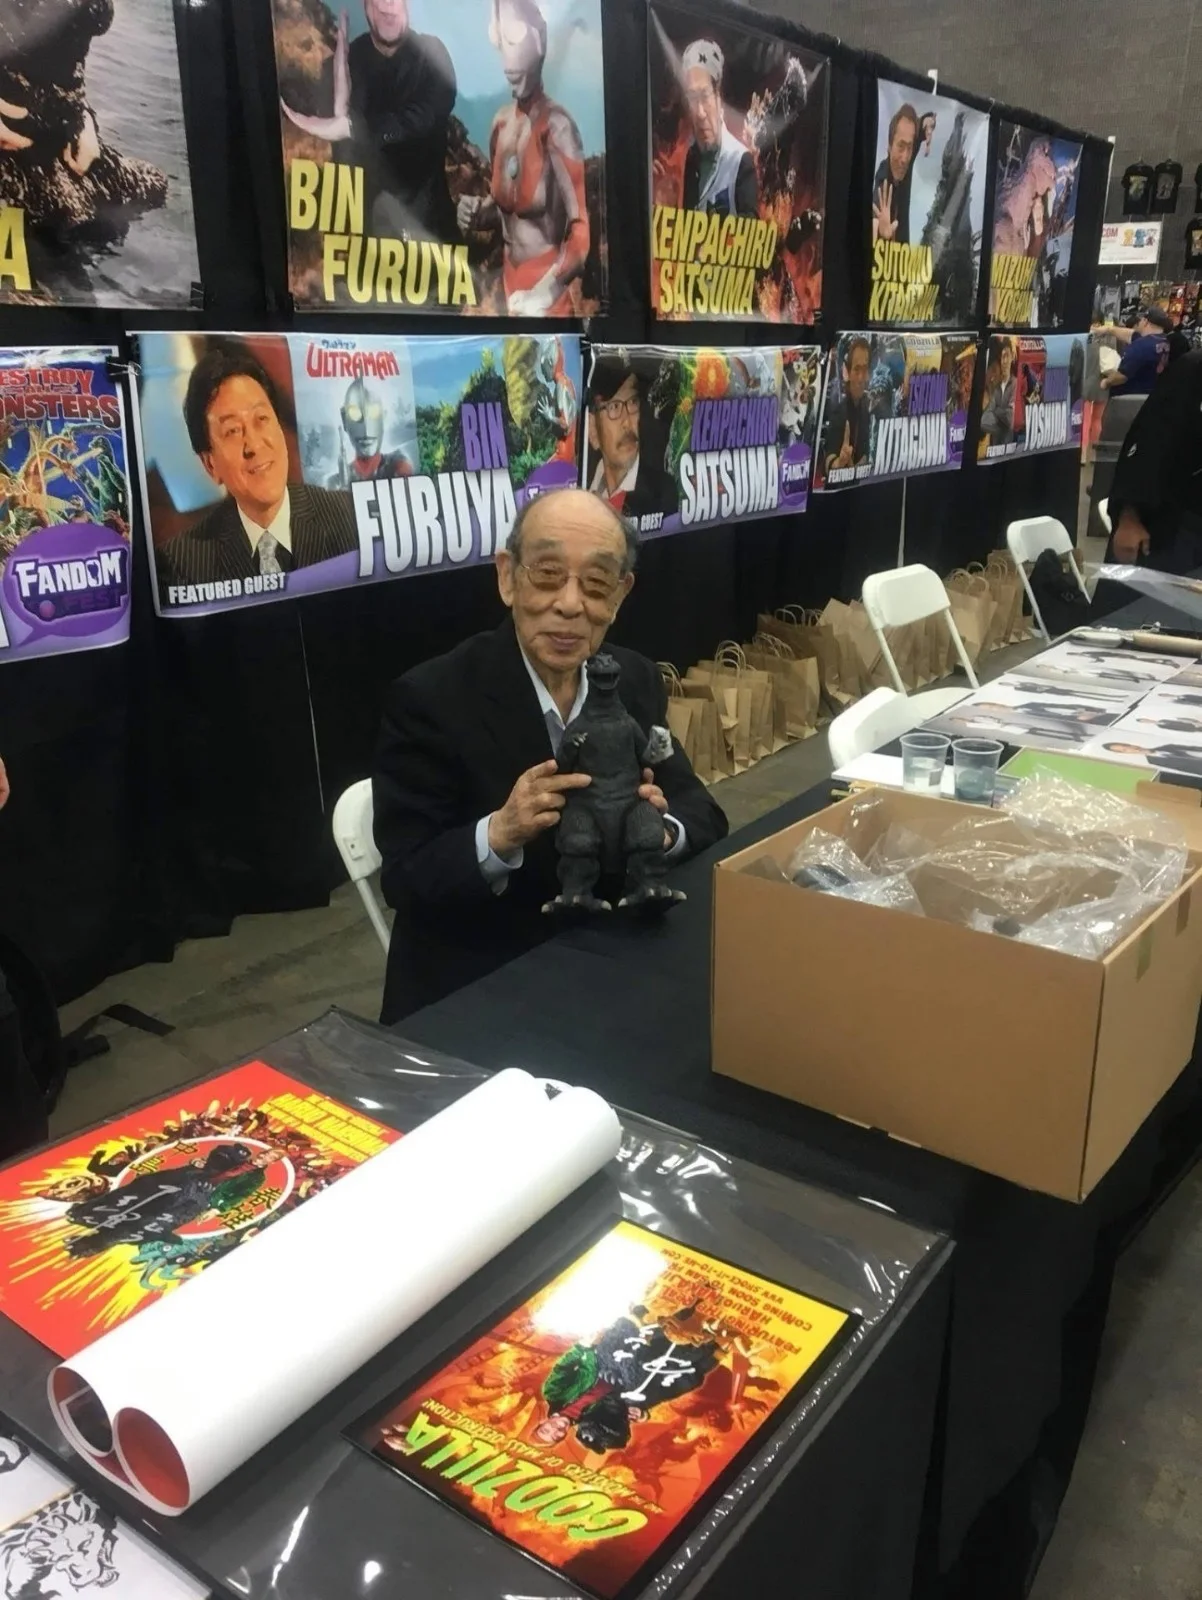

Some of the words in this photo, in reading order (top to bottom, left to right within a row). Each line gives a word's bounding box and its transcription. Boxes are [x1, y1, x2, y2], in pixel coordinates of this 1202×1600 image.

[291, 158, 364, 234] BIN
[323, 234, 477, 305] FURUYA
[660, 260, 756, 315] SATSUMA
[306, 342, 400, 380] ULTRAMAN
[461, 402, 509, 471] BIN
[692, 397, 779, 451] KENPACHIRO
[874, 413, 947, 475] KITAGAWA
[1024, 401, 1067, 451] YOSHIDA
[680, 446, 778, 525] SATSUMA
[352, 470, 517, 577] FURUYA
[641, 512, 664, 531] GUEST
[15, 550, 122, 597] FANDOM
[169, 578, 242, 604] FEATURED
[244, 571, 286, 595] GUEST
[728, 1287, 759, 1308] SOON
[402, 1411, 648, 1540] GODZILLA
[506, 1438, 543, 1461] MASS
[542, 1455, 563, 1468] OF
[561, 1463, 634, 1498] MONSTERS
